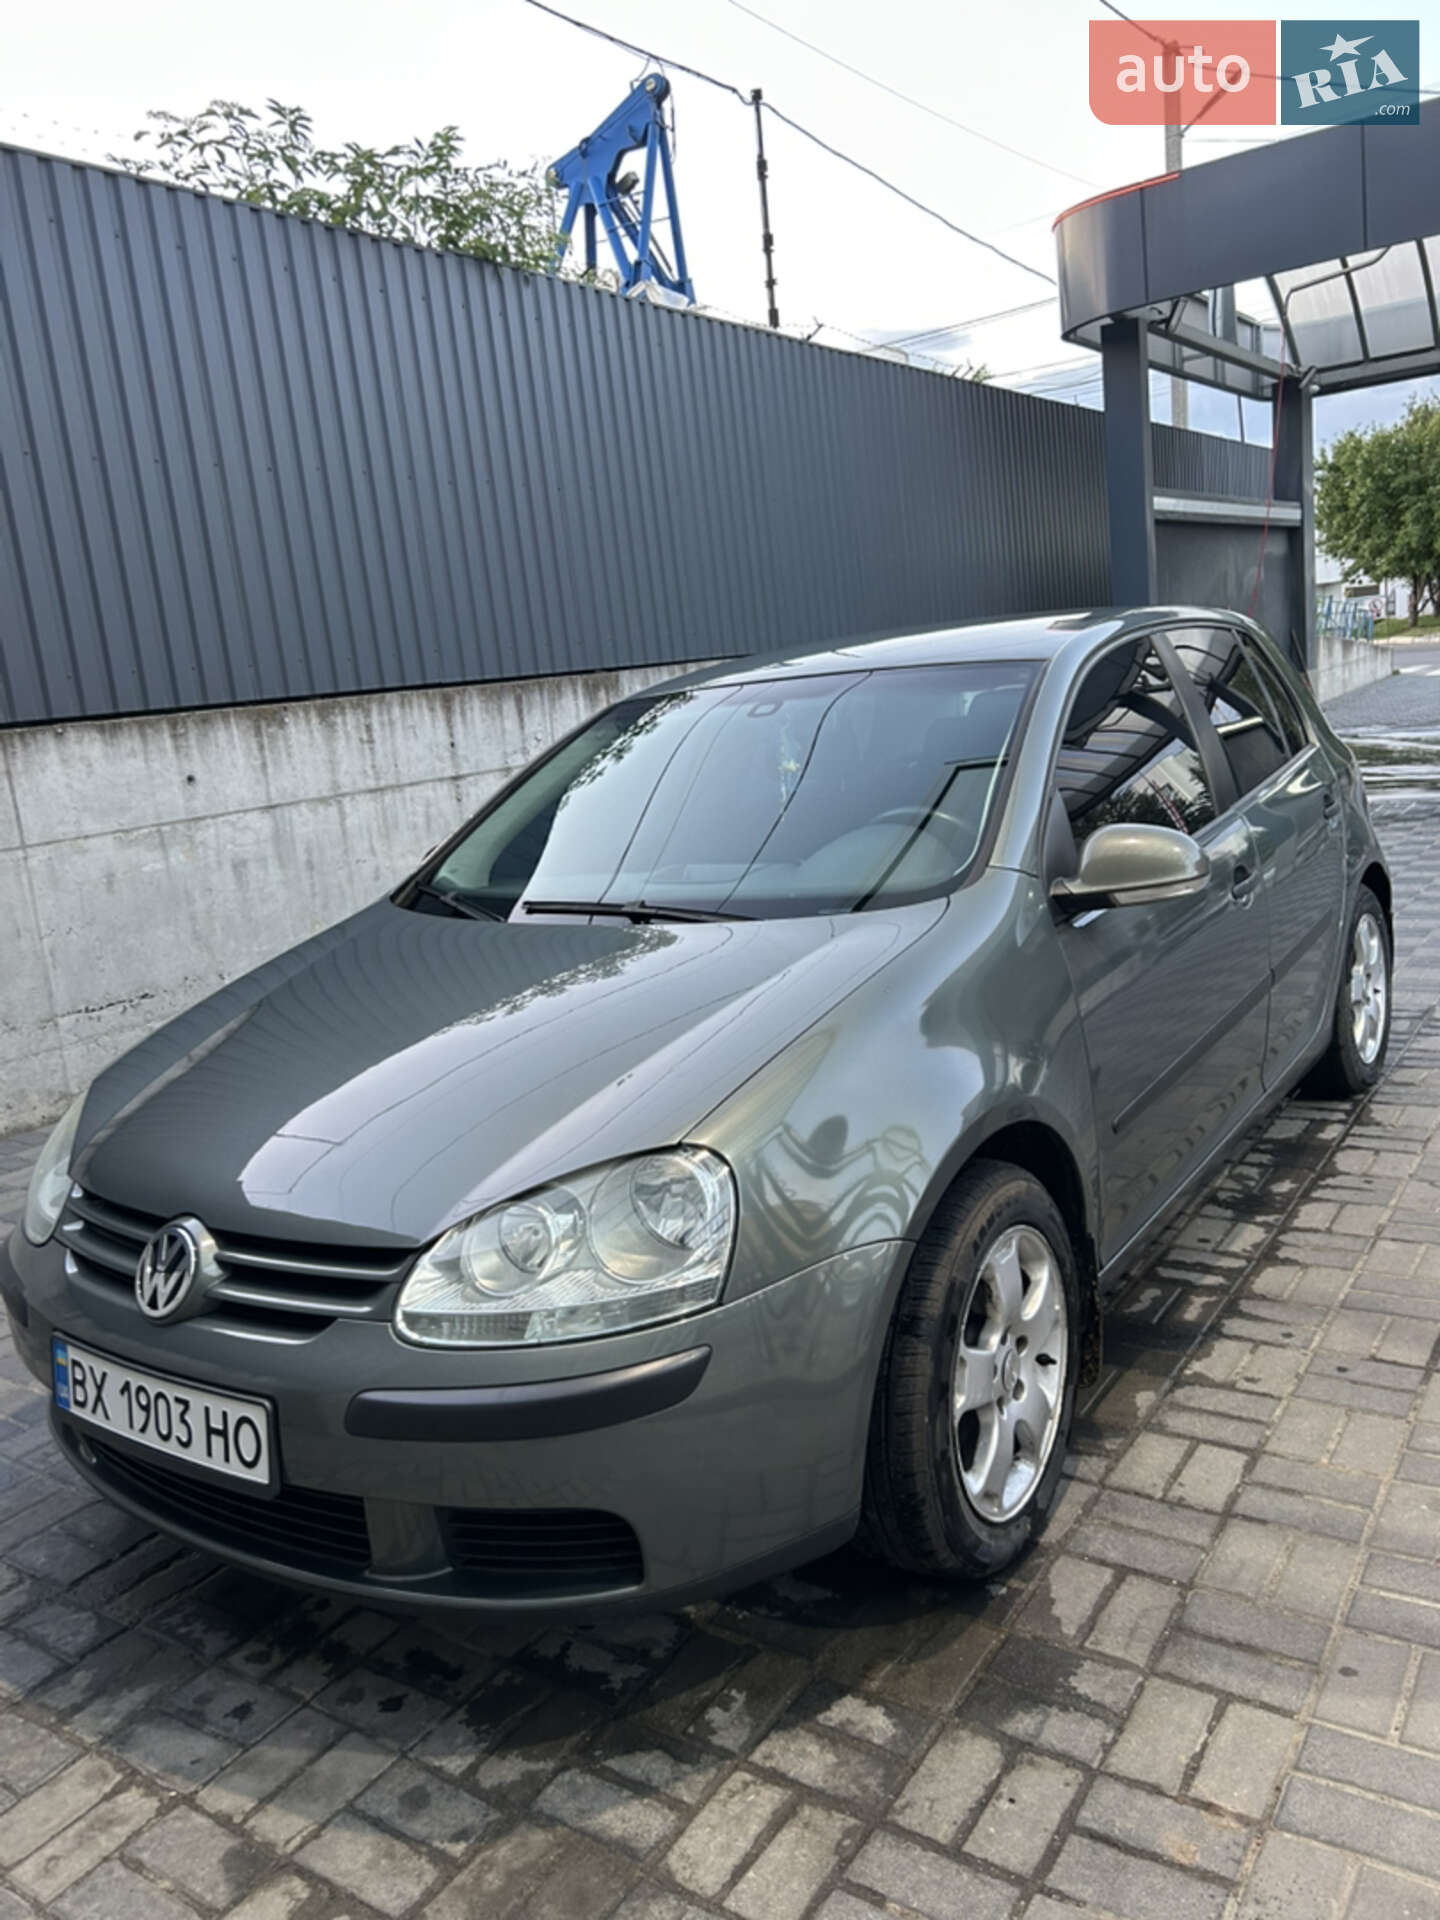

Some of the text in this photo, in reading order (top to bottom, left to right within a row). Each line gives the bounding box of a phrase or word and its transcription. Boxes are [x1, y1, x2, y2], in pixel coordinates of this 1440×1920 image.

[70, 1359, 262, 1469] BX 1903 HO
